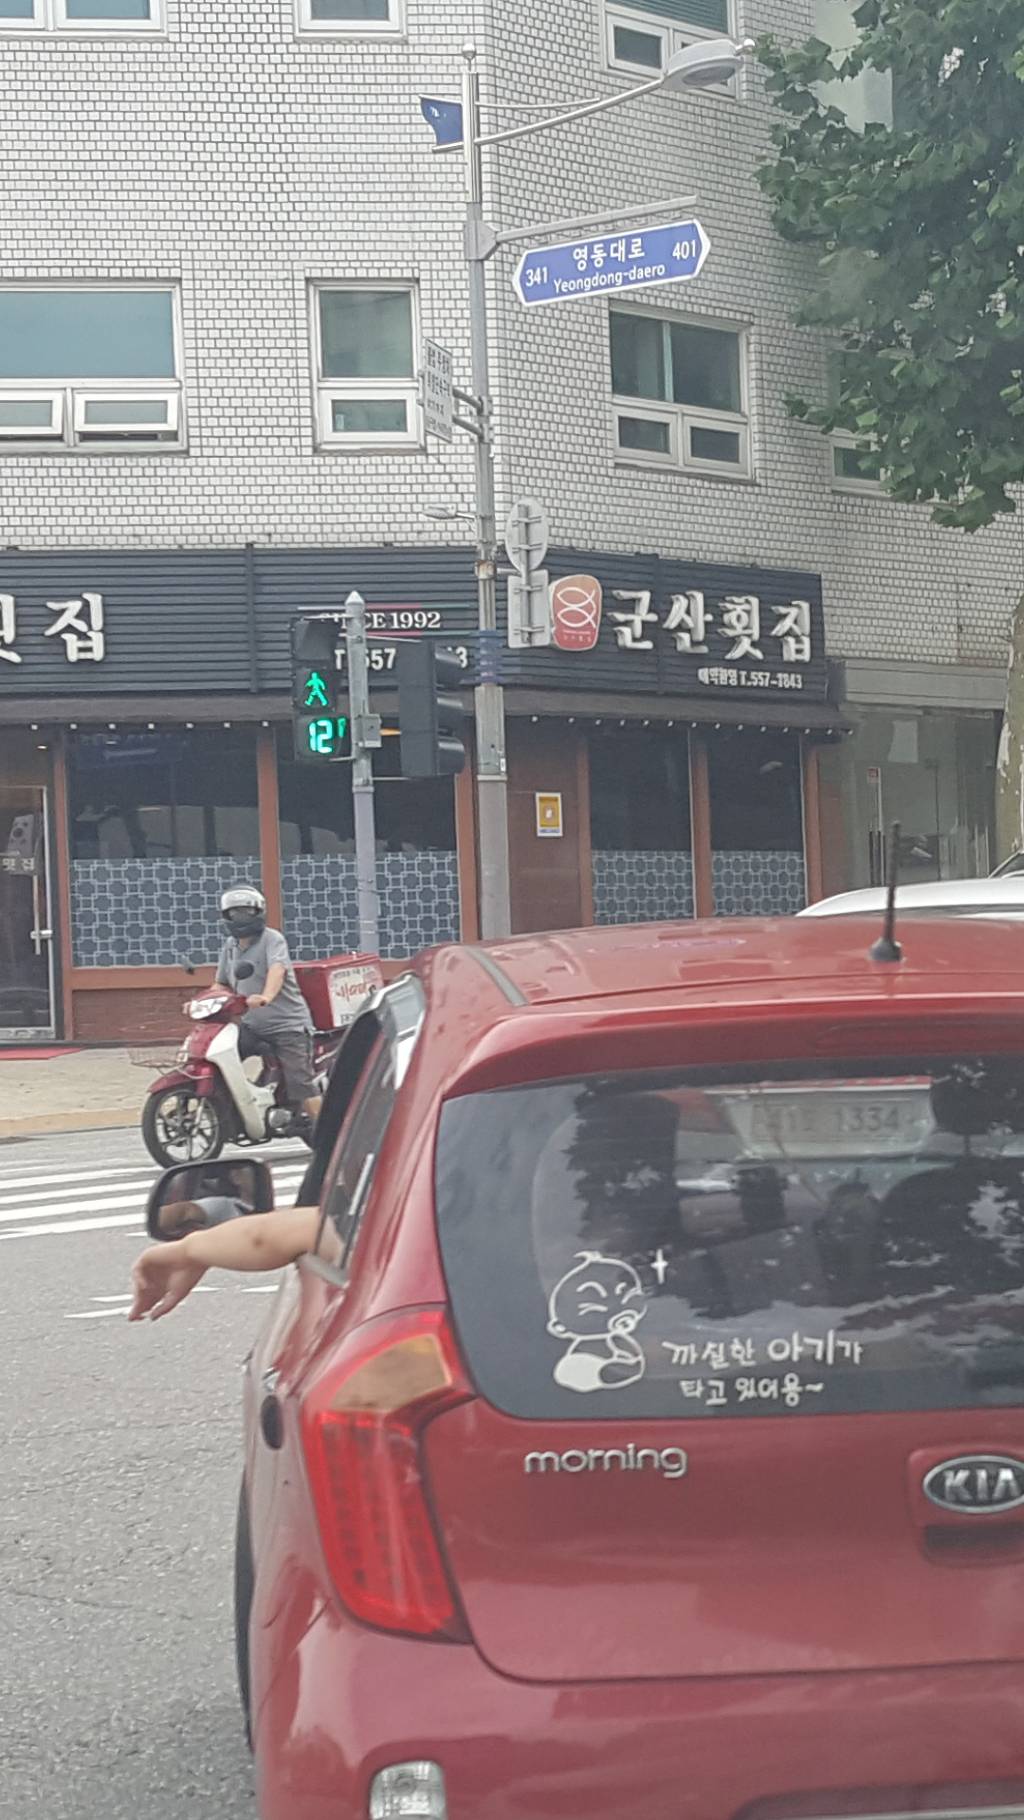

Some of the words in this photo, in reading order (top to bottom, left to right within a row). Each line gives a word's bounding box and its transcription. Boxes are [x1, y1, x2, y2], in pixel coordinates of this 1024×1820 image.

[572, 237, 645, 271] 영동대로
[672, 239, 697, 261] 401
[525, 266, 548, 287] 341
[553, 263, 666, 294] Yeongdong-daero
[389, 611, 441, 629] 1992
[606, 590, 811, 663] 군산횟집
[767, 1328, 863, 1365] 아기가
[679, 1378, 729, 1406] 타고
[524, 1442, 688, 1478] morning
[943, 1467, 1021, 1501] KIA
